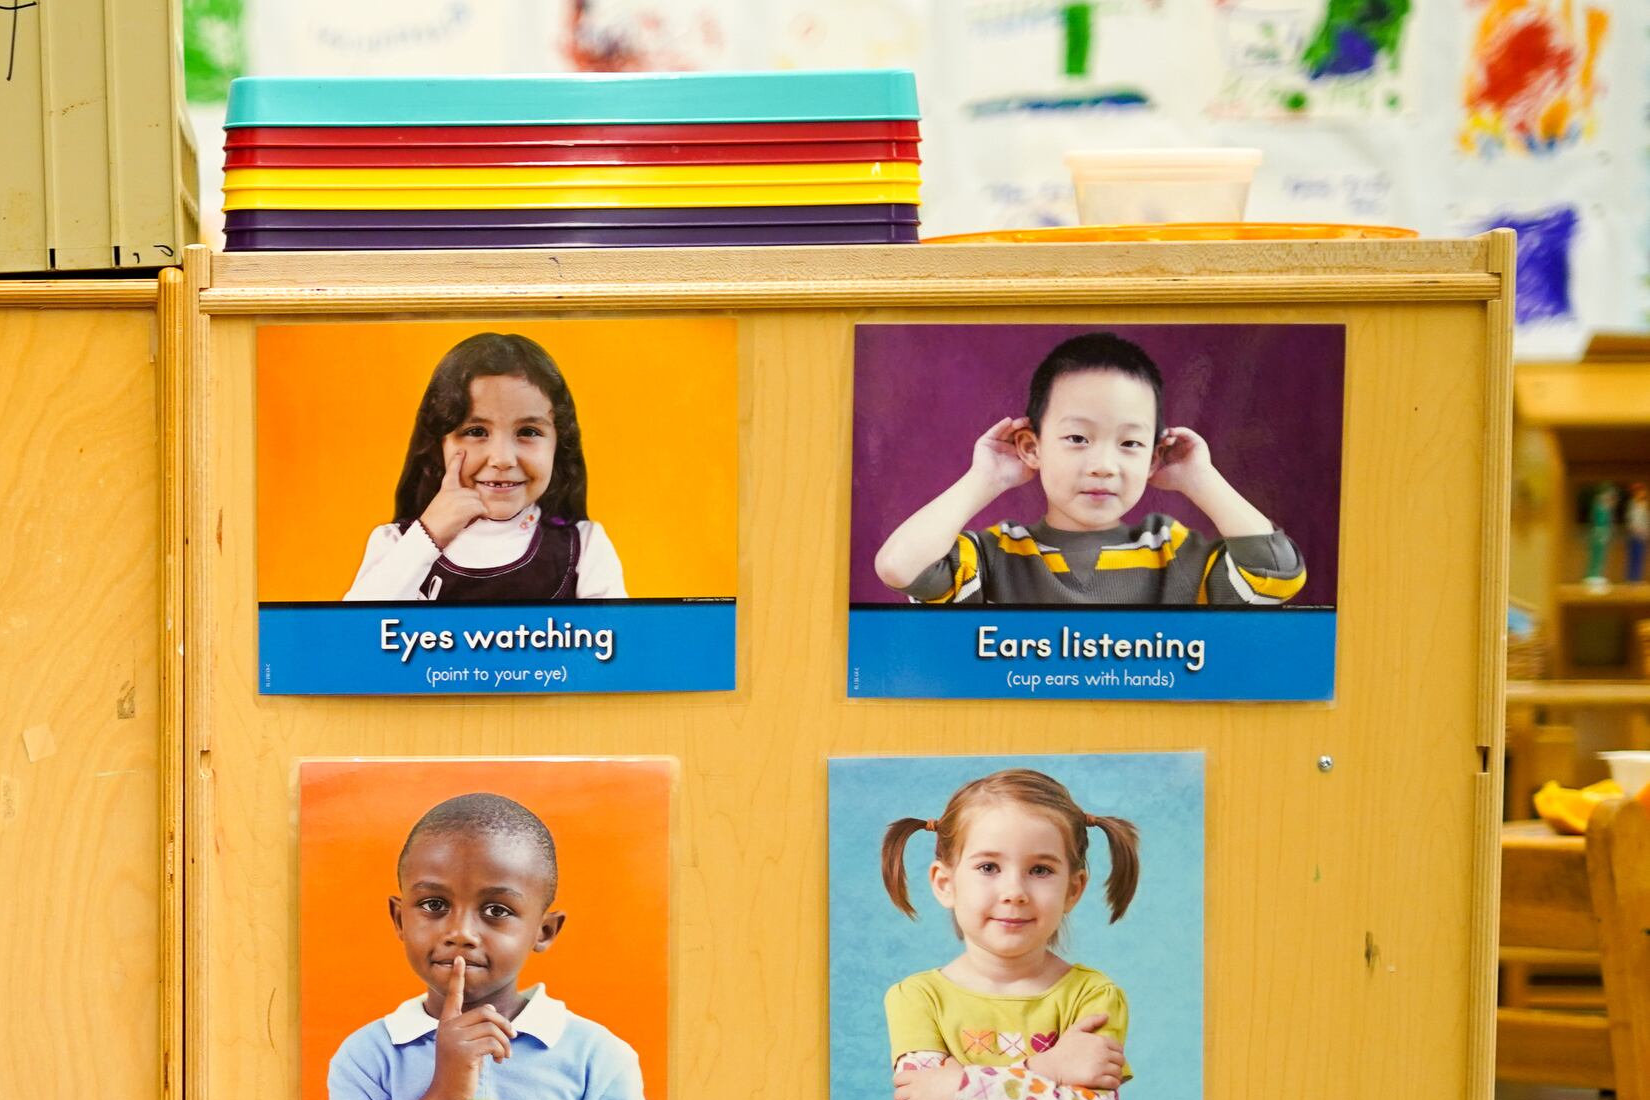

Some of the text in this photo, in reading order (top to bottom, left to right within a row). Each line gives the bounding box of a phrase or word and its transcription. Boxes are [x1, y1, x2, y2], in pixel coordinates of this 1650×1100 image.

[379, 616, 614, 663] Eyes watching
[978, 625, 1206, 671] Ears listening
[426, 666, 568, 688] (point to your eye)
[1006, 669, 1176, 690] (cup ears with hands)
